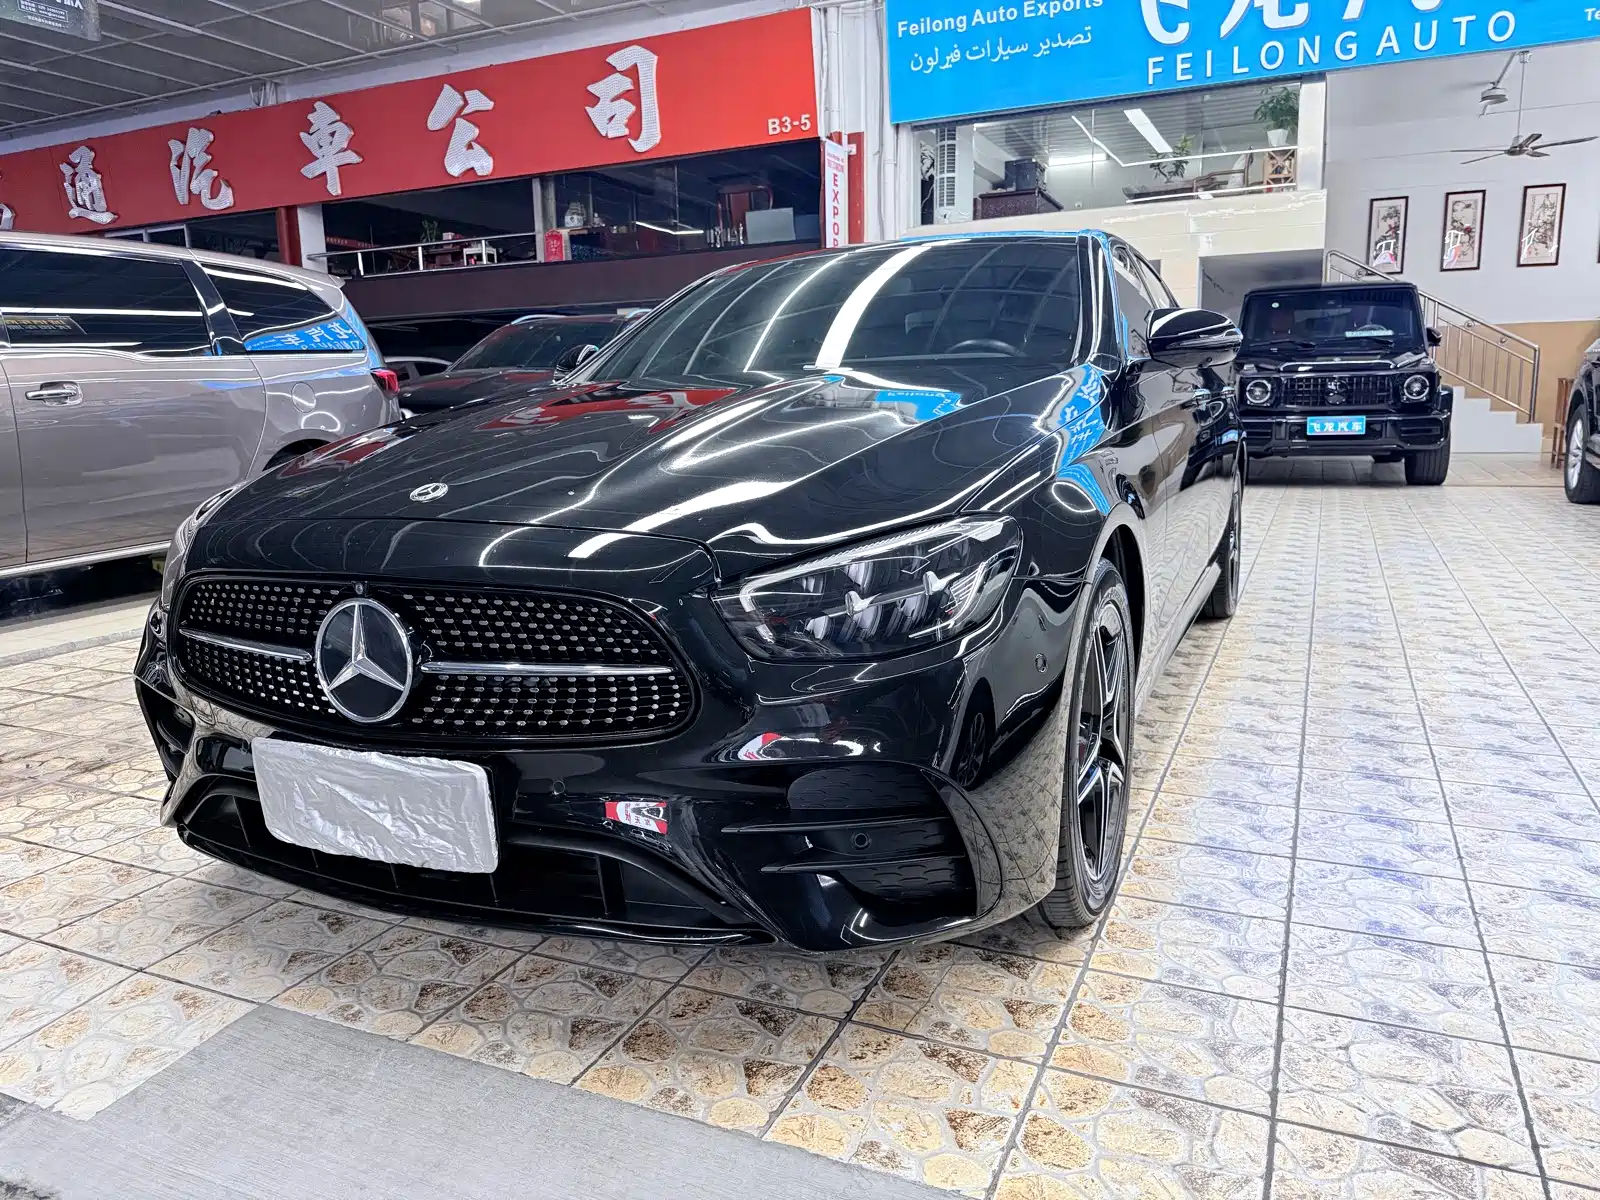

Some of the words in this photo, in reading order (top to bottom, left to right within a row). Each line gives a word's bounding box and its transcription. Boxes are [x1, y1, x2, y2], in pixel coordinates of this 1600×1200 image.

[897, 13, 967, 38] Feilong
[971, 6, 1018, 27] Auto
[966, 36, 1029, 62] سيارات
[1033, 26, 1092, 57] تصدير
[768, 114, 811, 136] B3-5
